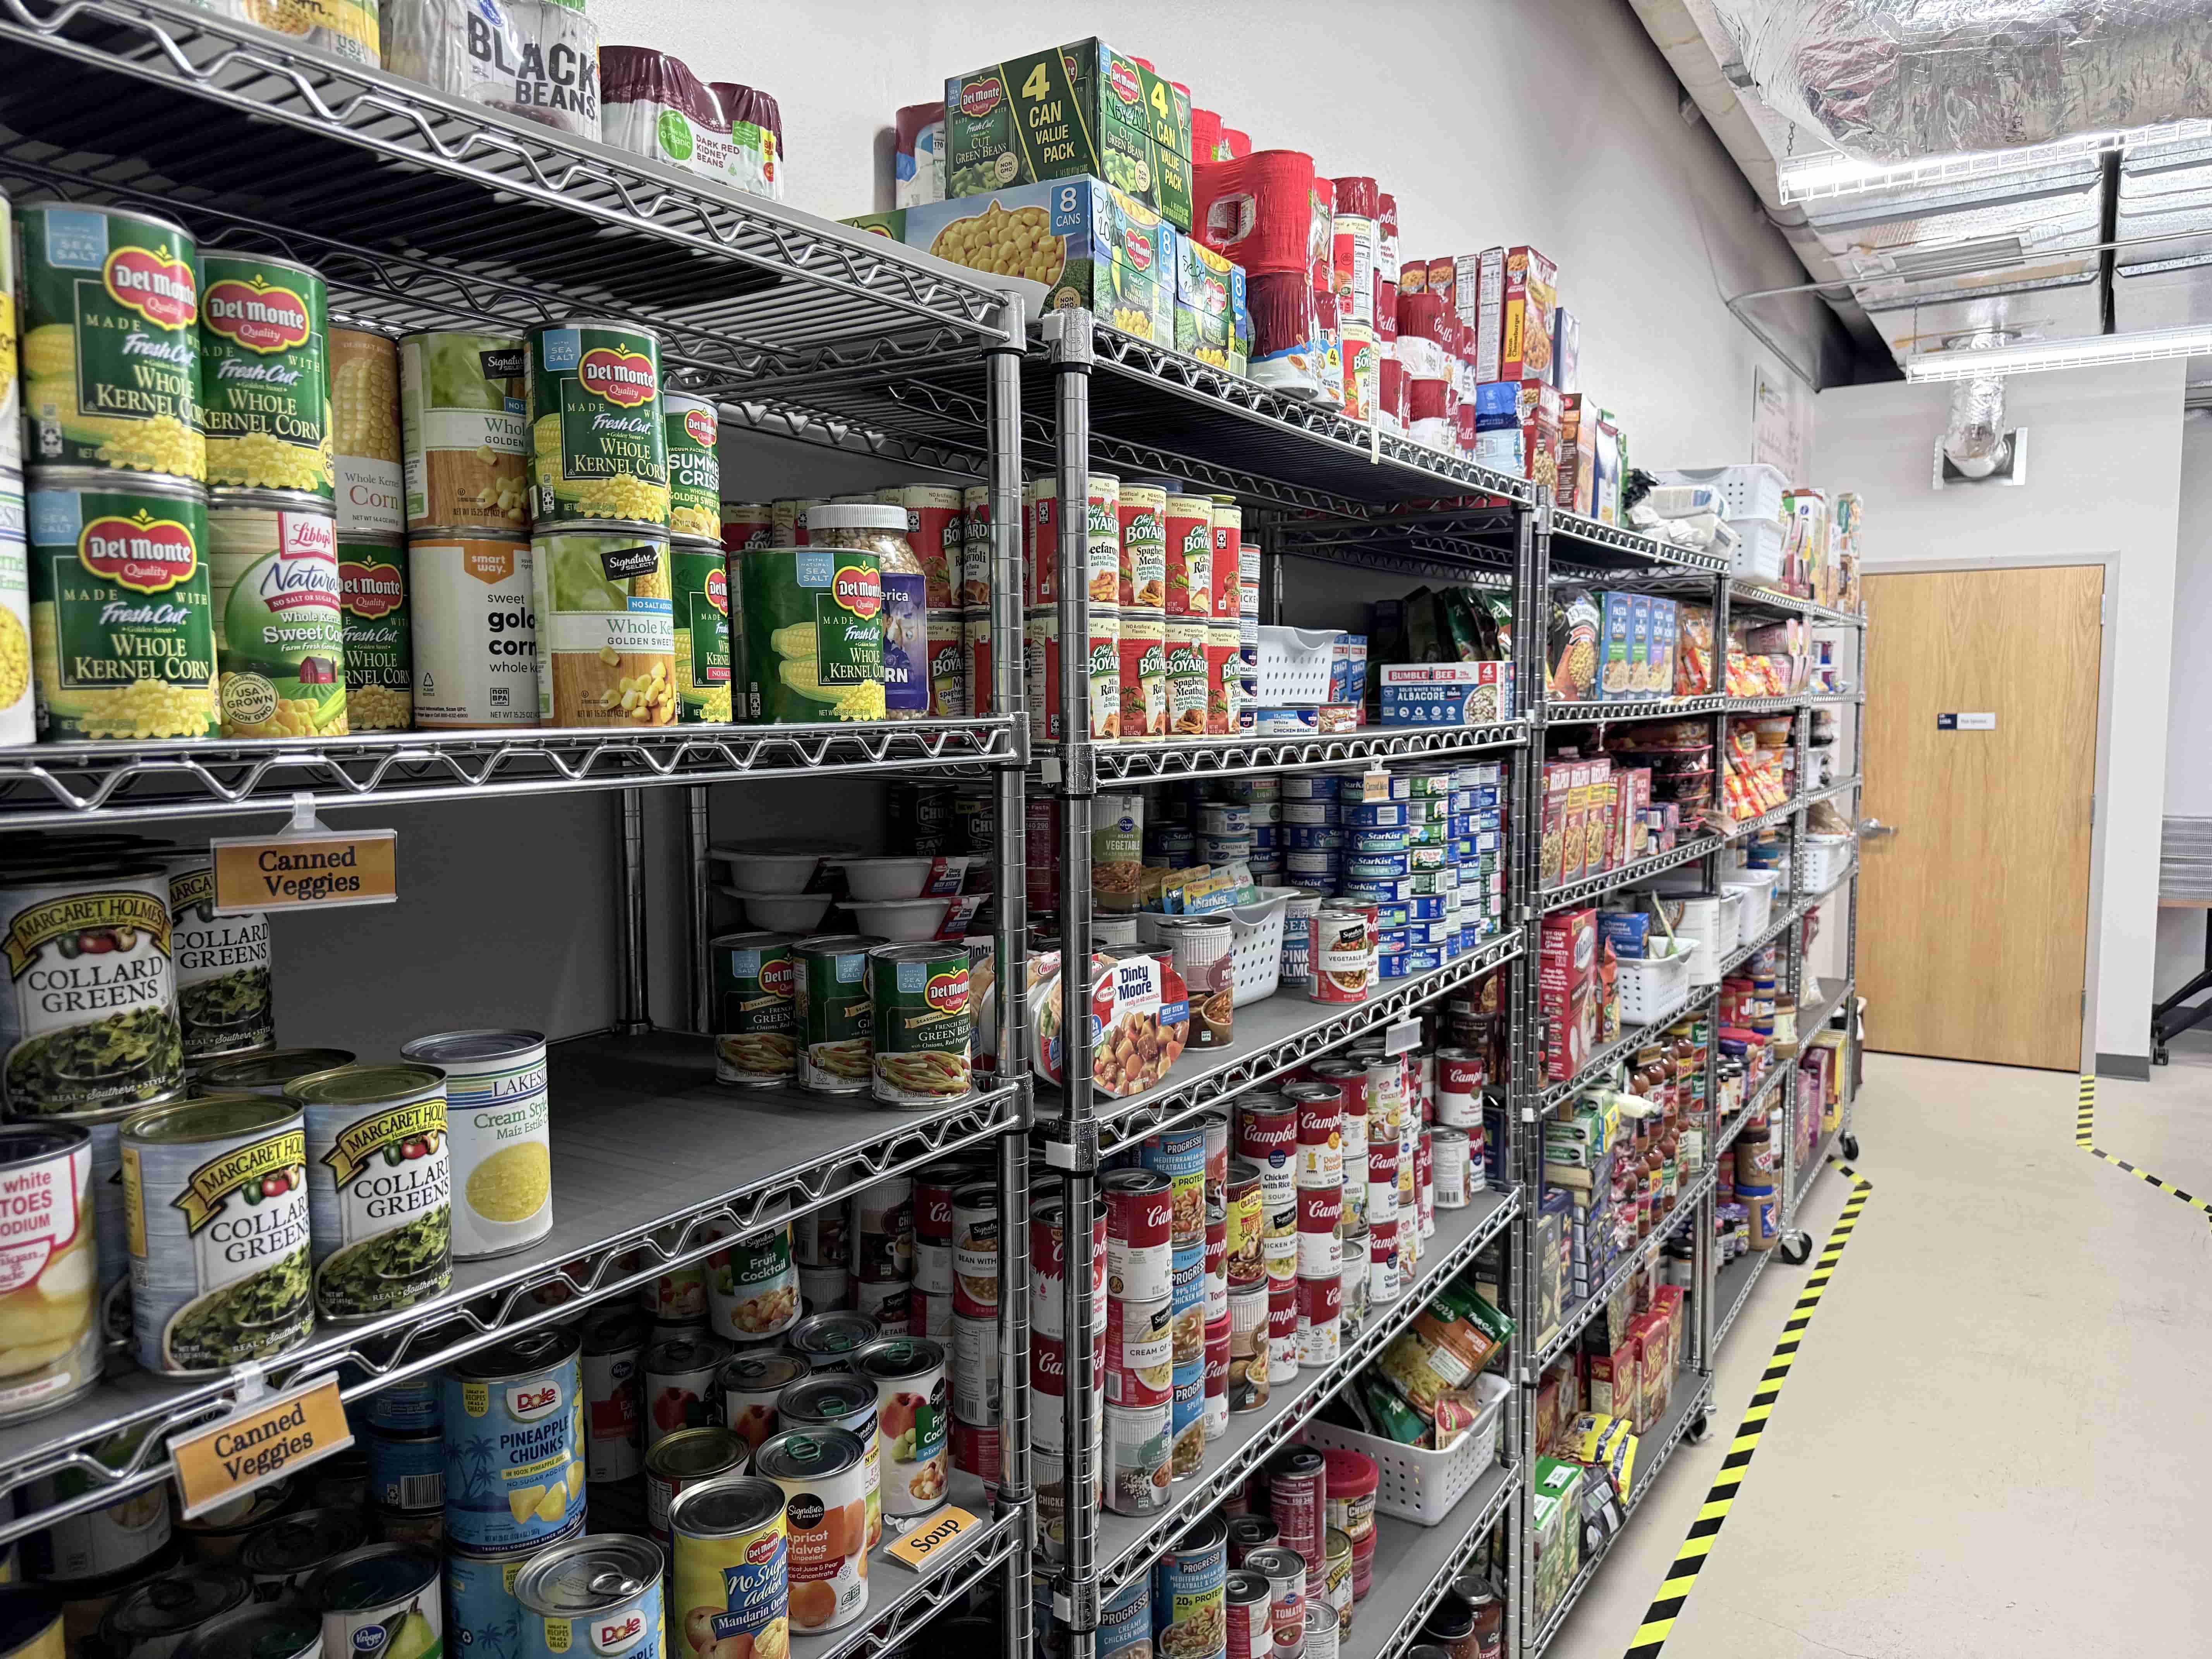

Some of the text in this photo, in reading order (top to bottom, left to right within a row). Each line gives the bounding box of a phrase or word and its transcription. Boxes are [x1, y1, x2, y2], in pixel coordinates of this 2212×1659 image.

[468, 10, 596, 98] BLACK
[1022, 62, 1050, 101] 4
[515, 79, 595, 121] BEANS
[963, 87, 1000, 105] Del Monte
[1151, 81, 1168, 119] 4
[1029, 100, 1061, 128] CAN
[971, 136, 990, 149] CUT
[1036, 124, 1069, 145] VALUE
[1119, 127, 1133, 142] CUT
[1156, 120, 1176, 149] CAN
[696, 134, 740, 155] DARK RED
[697, 144, 727, 160] KIDNEY
[956, 143, 1006, 164] GREEN BEANS
[1044, 142, 1075, 163] PACK
[697, 153, 723, 168] BEANS
[1161, 148, 1179, 172] VALUE
[1165, 170, 1182, 193] PACK
[1060, 187, 1077, 212] 8
[1056, 213, 1081, 227] CANS
[1163, 231, 1171, 254] 8
[115, 265, 150, 291] Del
[1235, 275, 1242, 297] 8
[85, 314, 142, 331] MADE
[210, 298, 304, 329] Del Monte
[1511, 313, 1520, 357] Cheeseburger
[549, 353, 576, 362] SALT
[551, 345, 572, 355] SEA
[1330, 350, 1336, 361] 4
[288, 354, 321, 373] WITH
[133, 364, 196, 400] WHOLE
[586, 363, 654, 388] Del Monte
[96, 383, 176, 416] KERNEL
[610, 384, 639, 398] Quality
[228, 389, 297, 416] WHOLE
[567, 402, 605, 412] MADE
[275, 415, 321, 441] CORN
[592, 414, 628, 432] Fresh
[484, 436, 524, 447] GOLDEN
[600, 438, 651, 460] WHOLE
[575, 454, 635, 474] KERNEL
[344, 472, 374, 485] Whole
[350, 485, 398, 510] Corn
[1133, 515, 1152, 526] Chef
[289, 522, 331, 546] Libby's
[89, 536, 192, 563] Del Monte
[471, 554, 505, 564] smart
[63, 589, 208, 606] MADE WITH
[356, 597, 386, 609] Quality
[487, 593, 525, 605] sweet
[644, 601, 658, 610] SALT
[856, 600, 874, 610] Quality
[607, 618, 653, 634] Whole
[823, 616, 854, 624] MADE
[263, 626, 322, 644] Sweet
[111, 634, 187, 658] WHOLE
[850, 647, 881, 663] WHOLE
[1093, 646, 1111, 657] Chef
[1170, 649, 1190, 659] Chef
[76, 657, 209, 680] KERNEL CORN
[347, 651, 397, 667] WHOLE
[830, 663, 871, 678] KERNEL
[1390, 671, 1427, 680] BUMBLE
[1483, 665, 1493, 674] 4
[227, 694, 273, 708] GROWN
[235, 687, 260, 697] USA
[1397, 692, 1445, 701] ALBACORE
[1105, 840, 1140, 851] VEGETABLE
[259, 846, 357, 872] Canned
[264, 872, 361, 899] Veggies
[1347, 883, 1377, 891] StarKist
[19, 900, 105, 937] MARGARET
[180, 943, 267, 969] GREENS
[29, 955, 163, 991] COLLARD
[1120, 965, 1148, 983] Dinty
[42, 981, 159, 1013] GREENS
[1098, 990, 1115, 1000] Hormel
[1118, 981, 1152, 1000] Moore
[916, 1013, 943, 1025] SEASONED
[1162, 1004, 1183, 1015] BEEF STEW
[919, 1028, 955, 1041] GREEN
[52, 1094, 78, 1102] REAL
[86, 1085, 137, 1099] Southern
[143, 1075, 166, 1088] STYLE
[474, 1112, 525, 1128] Cream
[497, 1117, 543, 1140] Maíz Estilo
[349, 1108, 421, 1152] MARGARET
[1167, 1135, 1202, 1154] PROGRESSO
[1156, 1163, 1186, 1171] MEATBALL
[3, 1171, 51, 1194] white
[1264, 1173, 1289, 1182] Chicken
[1276, 1180, 1290, 1189] Rice
[367, 1178, 450, 1218] GREENS
[750, 1252, 778, 1269] Fruit
[958, 1254, 975, 1265] BEAN
[741, 1258, 787, 1283] Cocktail
[1129, 1348, 1157, 1356] CREAM
[517, 1387, 556, 1409] Dole
[214, 1403, 307, 1458] Canned
[500, 1416, 569, 1450] PINEAPPLE
[223, 1431, 314, 1481] Veggies
[510, 1435, 564, 1464] CHUNKS
[788, 1505, 823, 1519] Signature
[910, 1517, 960, 1553] Soup
[803, 1563, 818, 1572] Juice
[824, 1561, 838, 1570] Pear
[1183, 1552, 1220, 1574] PROGRESSO
[728, 1551, 787, 1595] No Sugar
[797, 1570, 833, 1579] Concentrate
[744, 1572, 782, 1607] Added
[1102, 1590, 1150, 1626] PROGRESSO
[1275, 1607, 1302, 1619] TOMATO
[719, 1606, 769, 1630] Mandarin
[1118, 1620, 1141, 1635] CREAMY
[356, 1629, 384, 1644] Kroger
